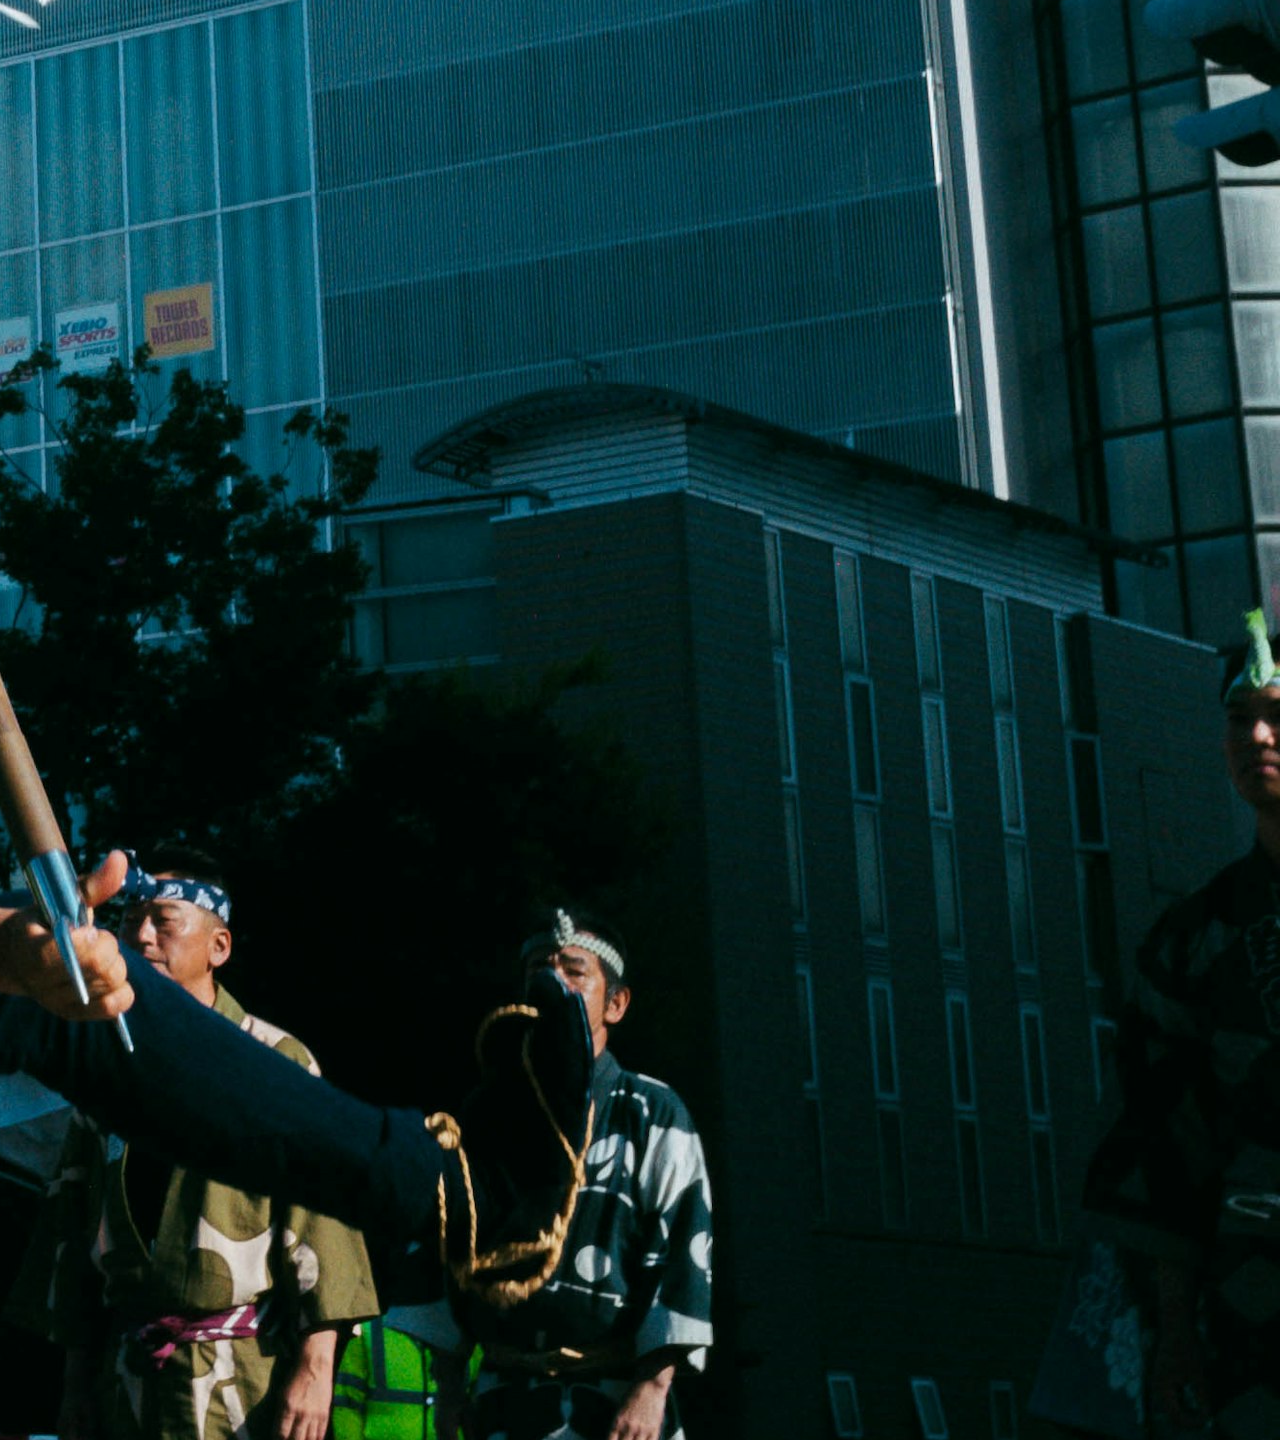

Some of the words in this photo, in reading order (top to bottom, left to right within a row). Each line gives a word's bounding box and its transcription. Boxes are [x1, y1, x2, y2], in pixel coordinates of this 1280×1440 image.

[154, 299, 200, 325] TOWER
[59, 316, 108, 336] XEBIO
[149, 317, 209, 346] RECORDS
[57, 327, 116, 347] SPORTS
[74, 344, 118, 360] EXPRESS
